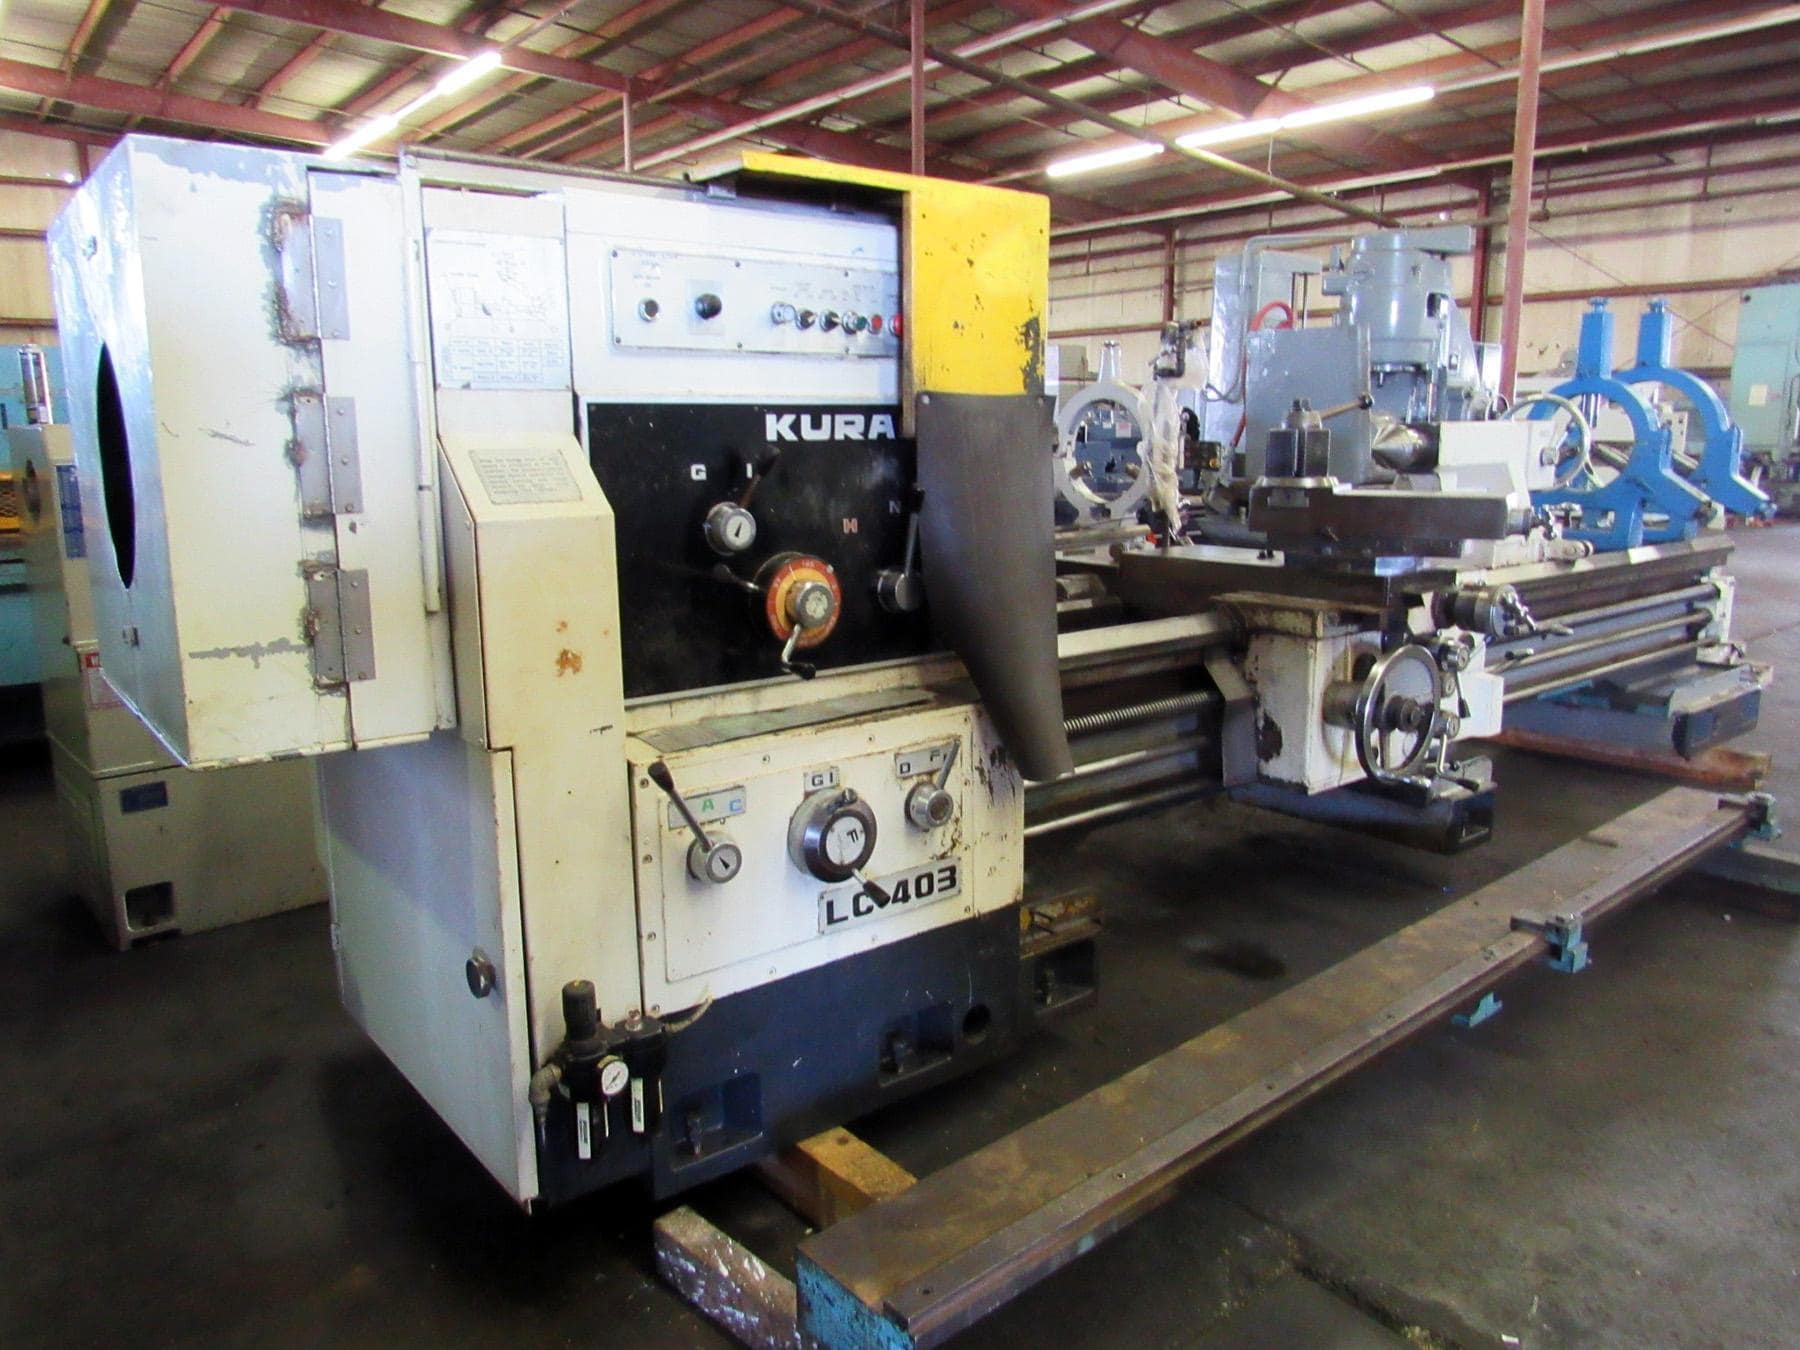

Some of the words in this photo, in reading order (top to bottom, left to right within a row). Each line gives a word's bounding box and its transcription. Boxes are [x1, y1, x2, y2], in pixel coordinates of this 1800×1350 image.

[765, 413, 895, 441] KURA
[690, 463, 707, 480] G
[811, 774, 824, 787] G
[702, 799, 715, 813] A
[729, 799, 744, 813] C
